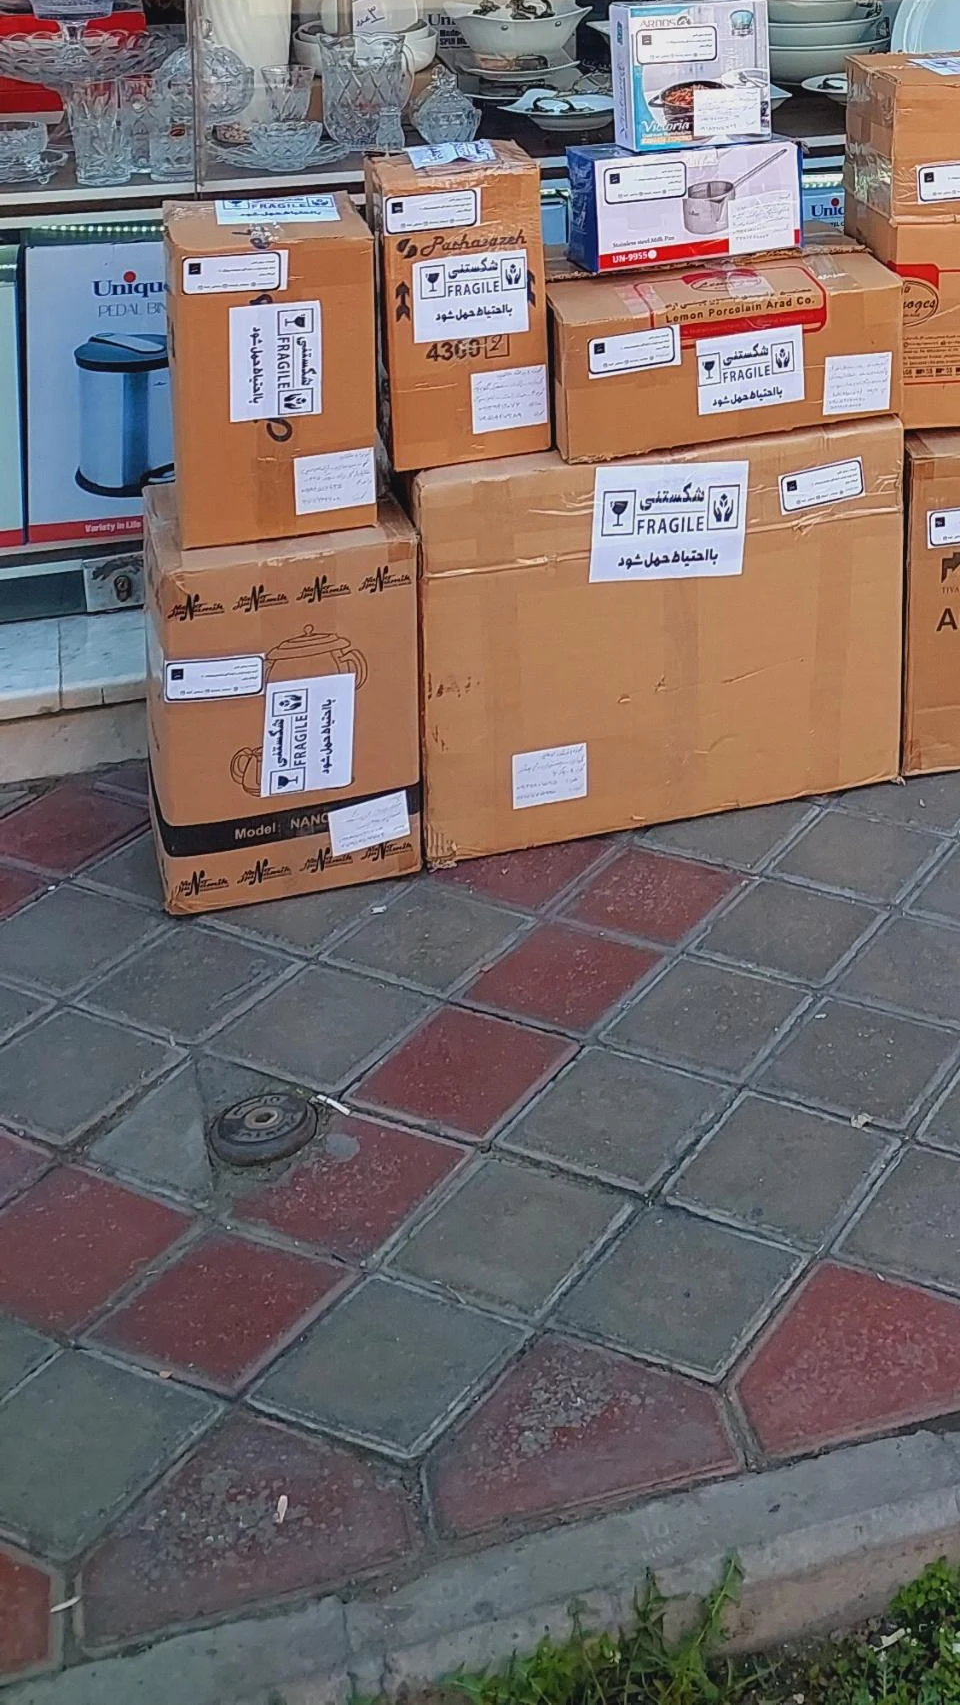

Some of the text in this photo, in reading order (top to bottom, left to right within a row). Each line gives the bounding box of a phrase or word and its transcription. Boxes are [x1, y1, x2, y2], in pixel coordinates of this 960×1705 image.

[811, 198, 845, 217] Uni
[612, 251, 648, 264] UN-9955
[448, 256, 499, 280] شکستنی
[447, 280, 500, 298] FRAGILE
[98, 302, 143, 318] PEDAL
[435, 311, 455, 322] شود
[456, 309, 476, 320] حمل
[665, 310, 704, 324] Lemon
[708, 303, 762, 317] Porcelain
[766, 299, 792, 310] Arad
[796, 296, 815, 306] Co.
[250, 327, 262, 347] شود
[250, 347, 263, 365] حمل
[277, 336, 290, 389] FRAGILE
[296, 336, 317, 386] شکستنی
[722, 343, 769, 366] شکستنی
[722, 365, 771, 383] FRAGILE
[712, 398, 730, 408] شود
[731, 395, 748, 405] حمل
[639, 482, 705, 511] شکستنی
[85, 522, 114, 534] Variety
[126, 521, 142, 531] Life
[637, 515, 704, 535] FRAGILE
[618, 556, 643, 570] شود
[645, 554, 671, 568] حمل
[268, 718, 288, 767] شکستنی
[294, 714, 308, 767] FRAGILE
[320, 735, 333, 755] حمل
[320, 756, 333, 775] شود
[234, 821, 281, 840] Model:
